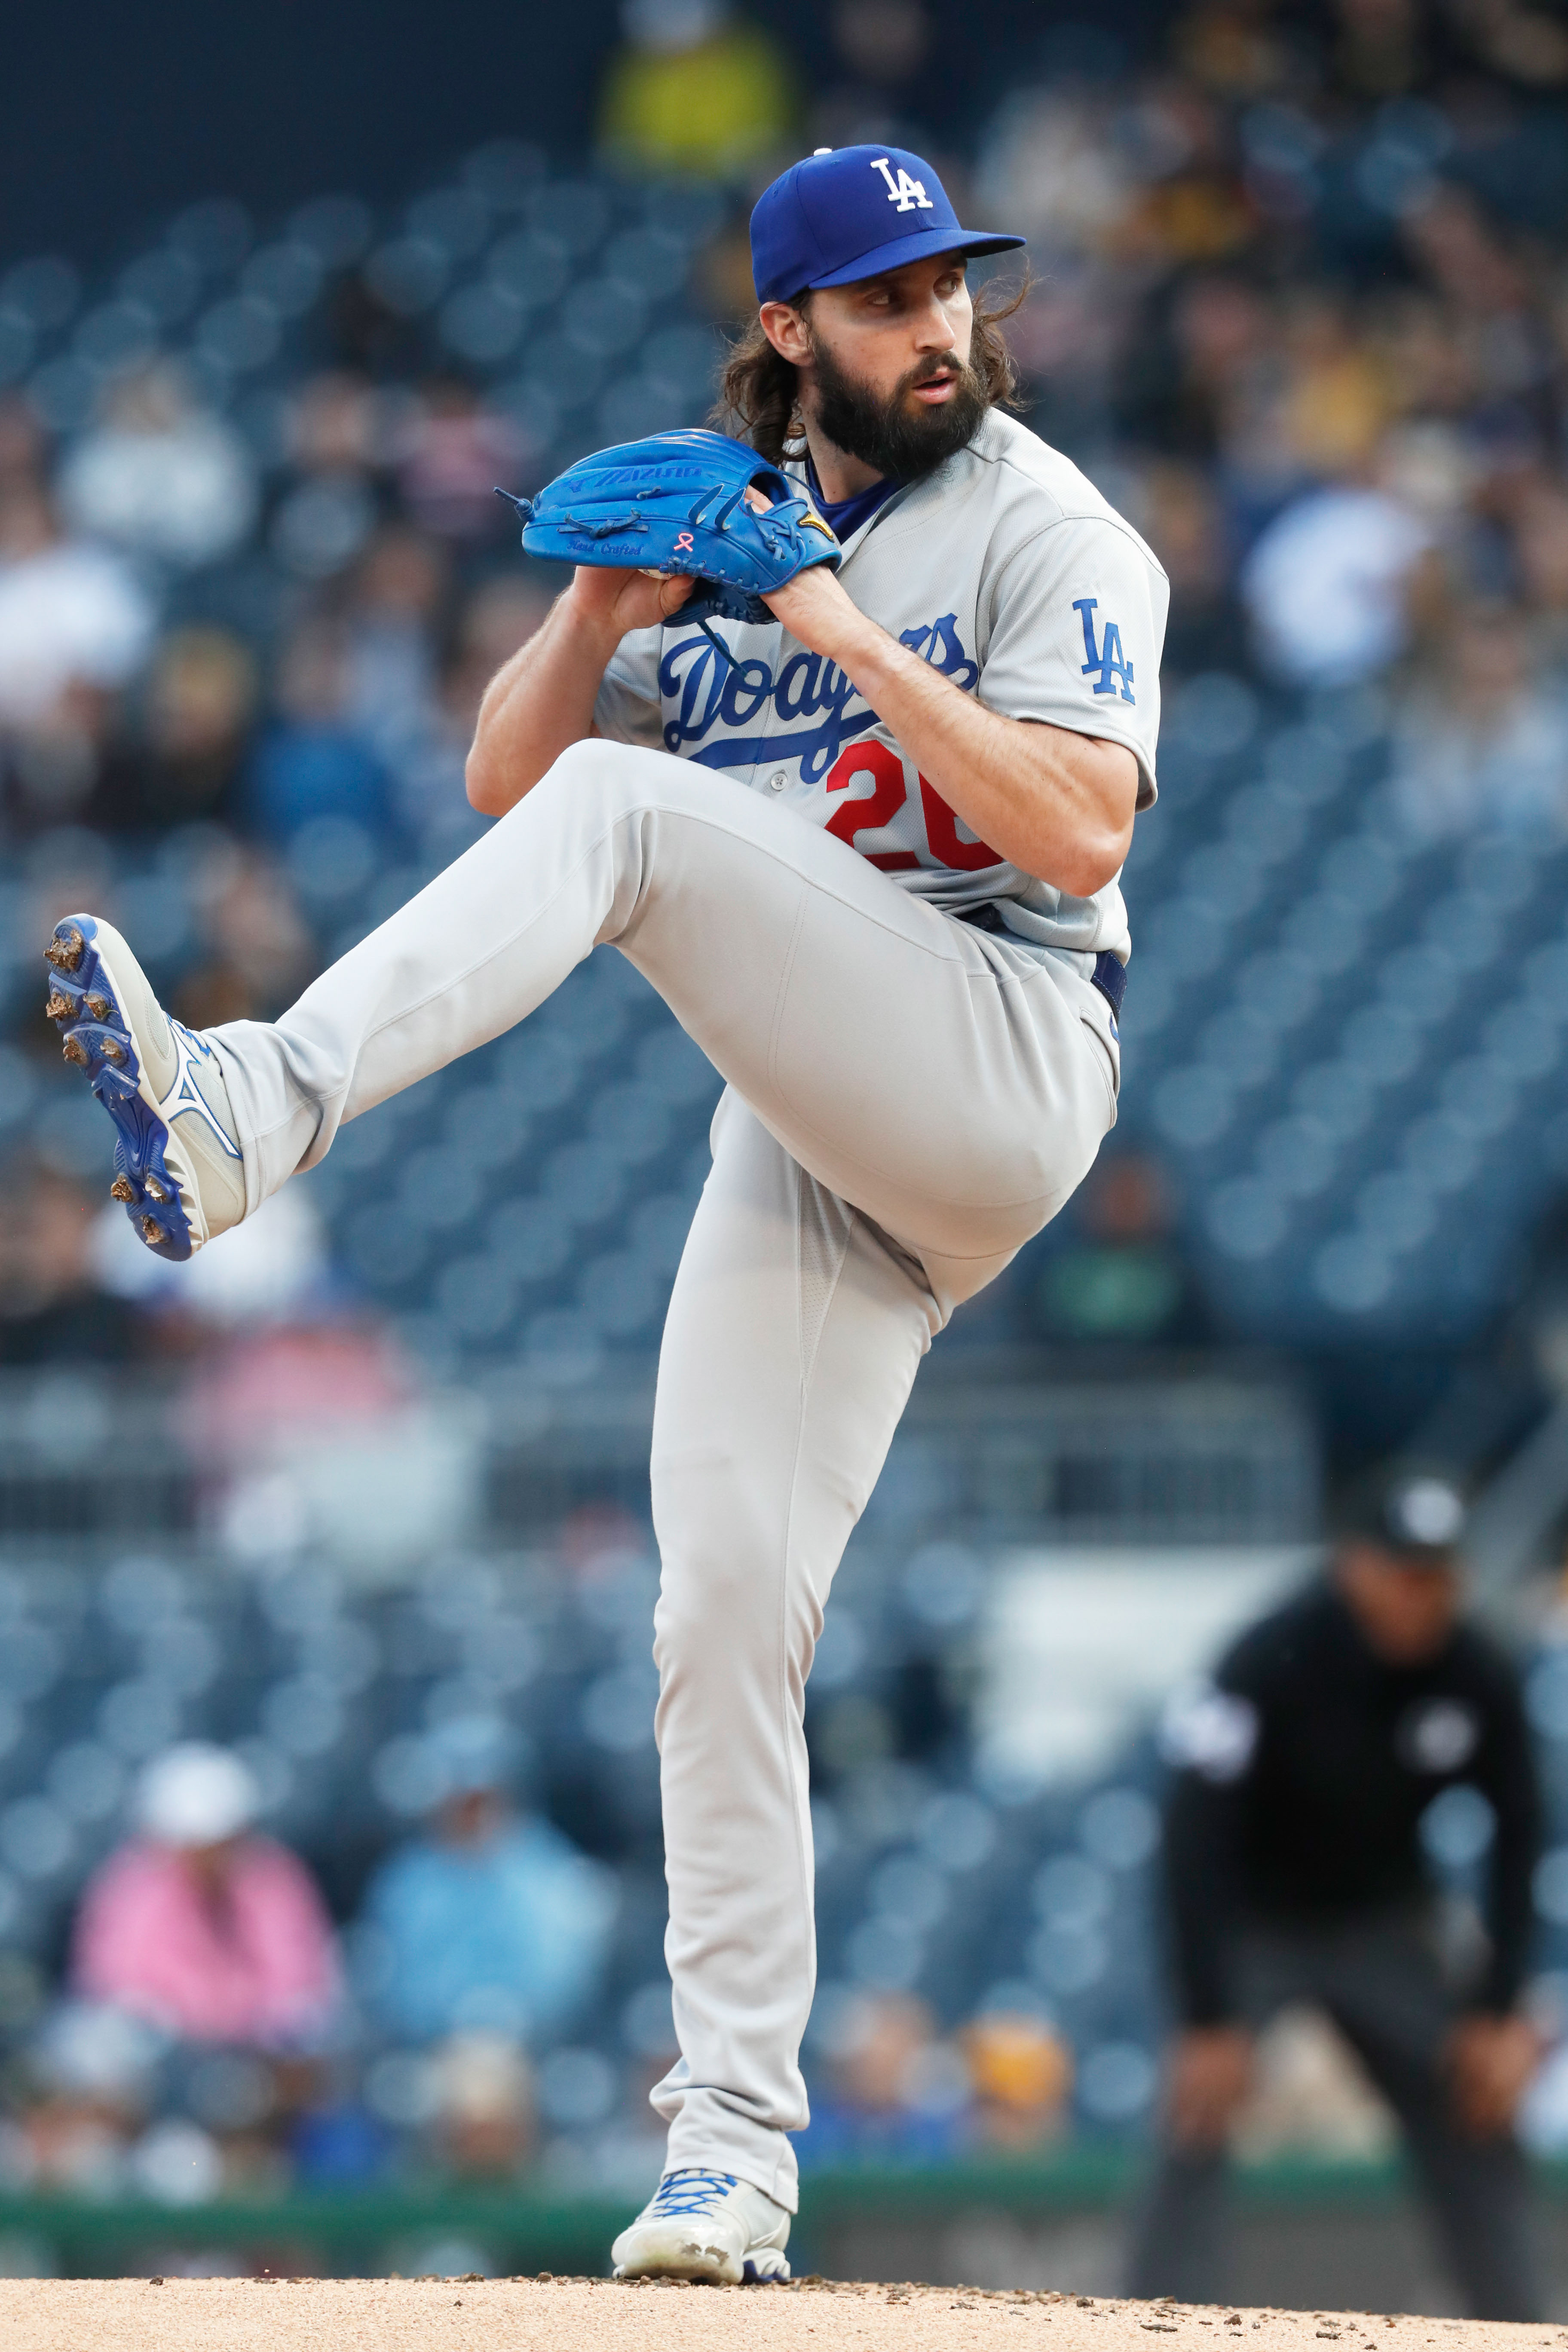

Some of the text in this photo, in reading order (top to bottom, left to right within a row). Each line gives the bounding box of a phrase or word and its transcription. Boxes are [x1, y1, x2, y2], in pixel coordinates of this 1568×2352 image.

[870, 158, 933, 213] LA
[567, 539, 645, 557] Hand Crafted
[1072, 598, 1136, 705] LA
[660, 612, 979, 784] Dodgrs
